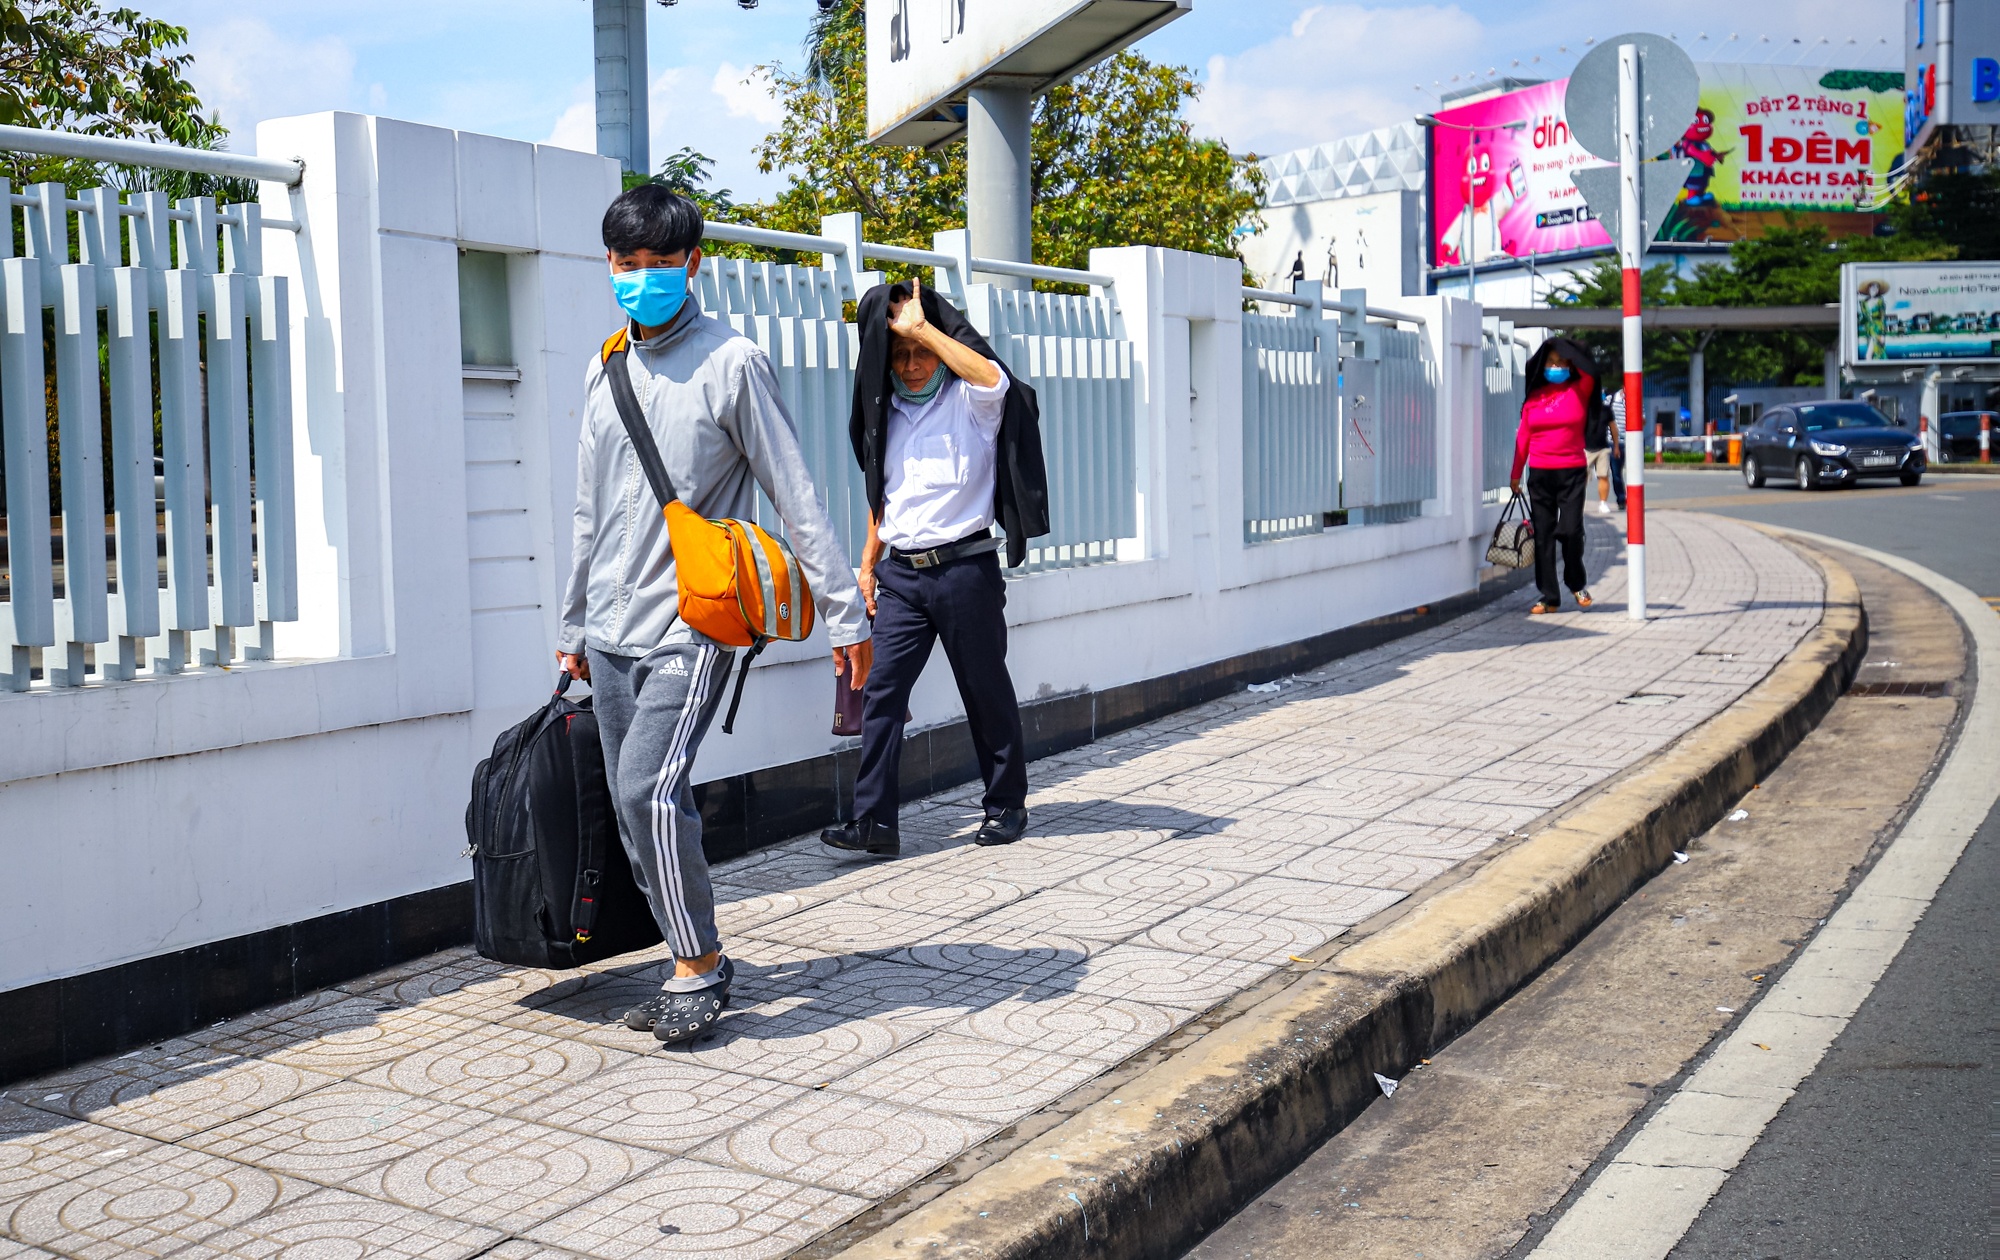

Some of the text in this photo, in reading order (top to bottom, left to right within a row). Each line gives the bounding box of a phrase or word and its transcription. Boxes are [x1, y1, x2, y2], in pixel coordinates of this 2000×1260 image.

[1746, 94, 1867, 119] ĐẶT 2 TẶNG 1
[1533, 115, 1572, 149] din
[1739, 124, 1870, 165] 1 ĐÊM
[1741, 167, 1820, 185] KHÁCH
[658, 667, 689, 677] adidas
